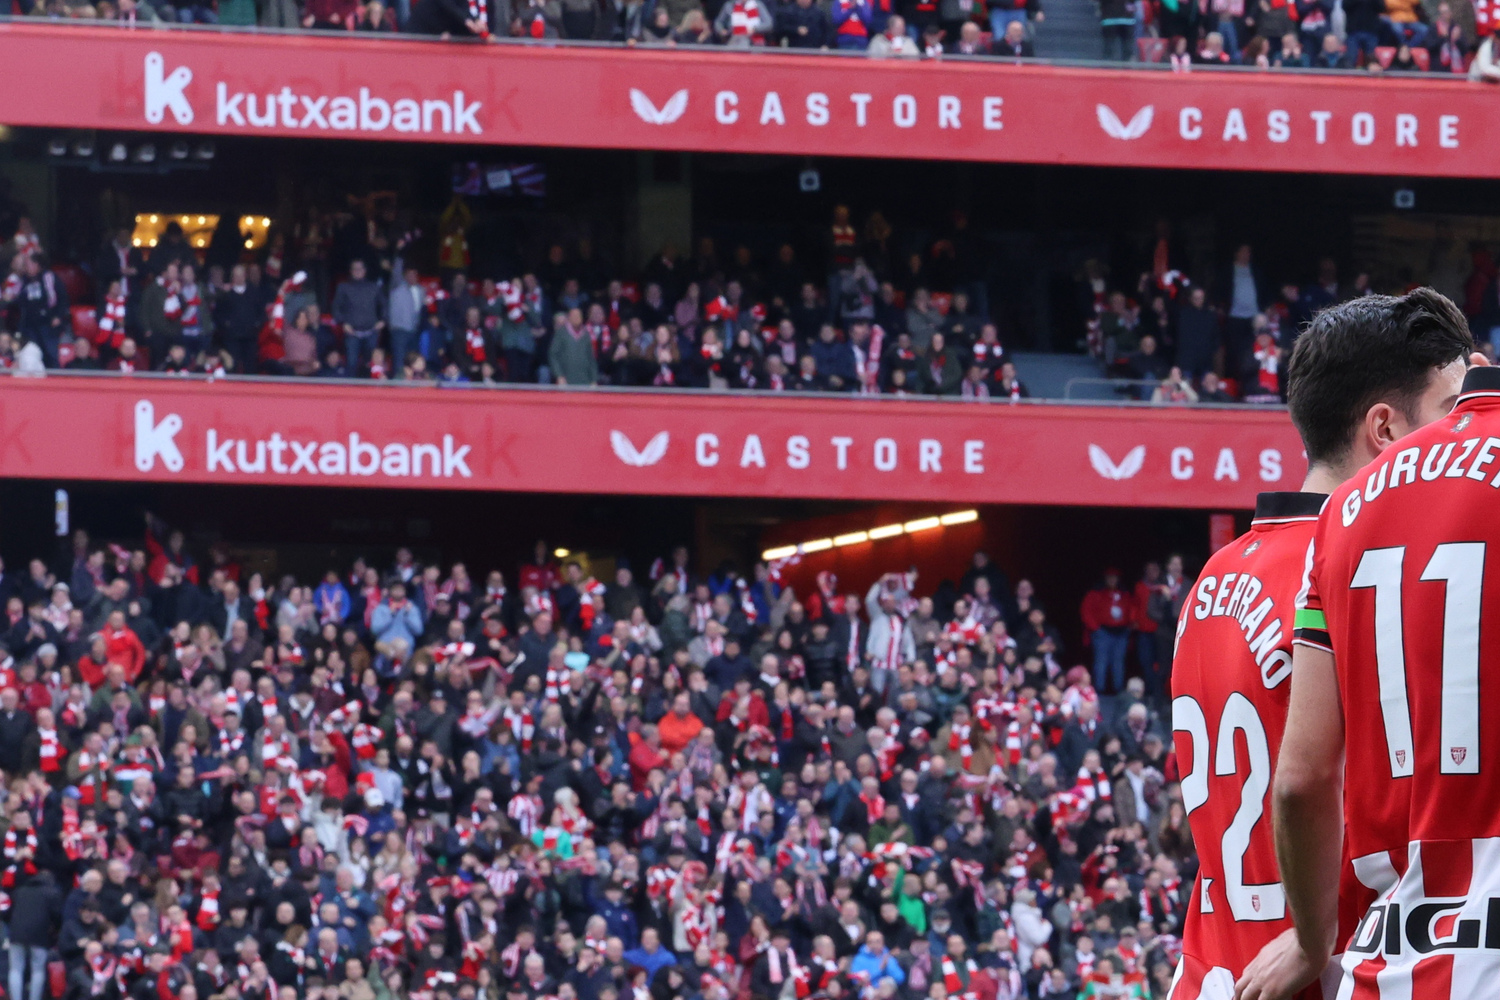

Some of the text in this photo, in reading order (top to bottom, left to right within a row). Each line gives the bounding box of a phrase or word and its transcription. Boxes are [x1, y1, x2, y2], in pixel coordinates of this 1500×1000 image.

[216, 82, 483, 135] kutxabank
[715, 90, 1004, 131] CASTORE
[1179, 106, 1460, 149] CASTORE
[206, 428, 472, 478] kutxabank
[695, 433, 985, 474] CASTORE
[1171, 446, 1307, 482] CAS
[1194, 572, 1293, 690] SERRANO
[1350, 541, 1487, 779] 11
